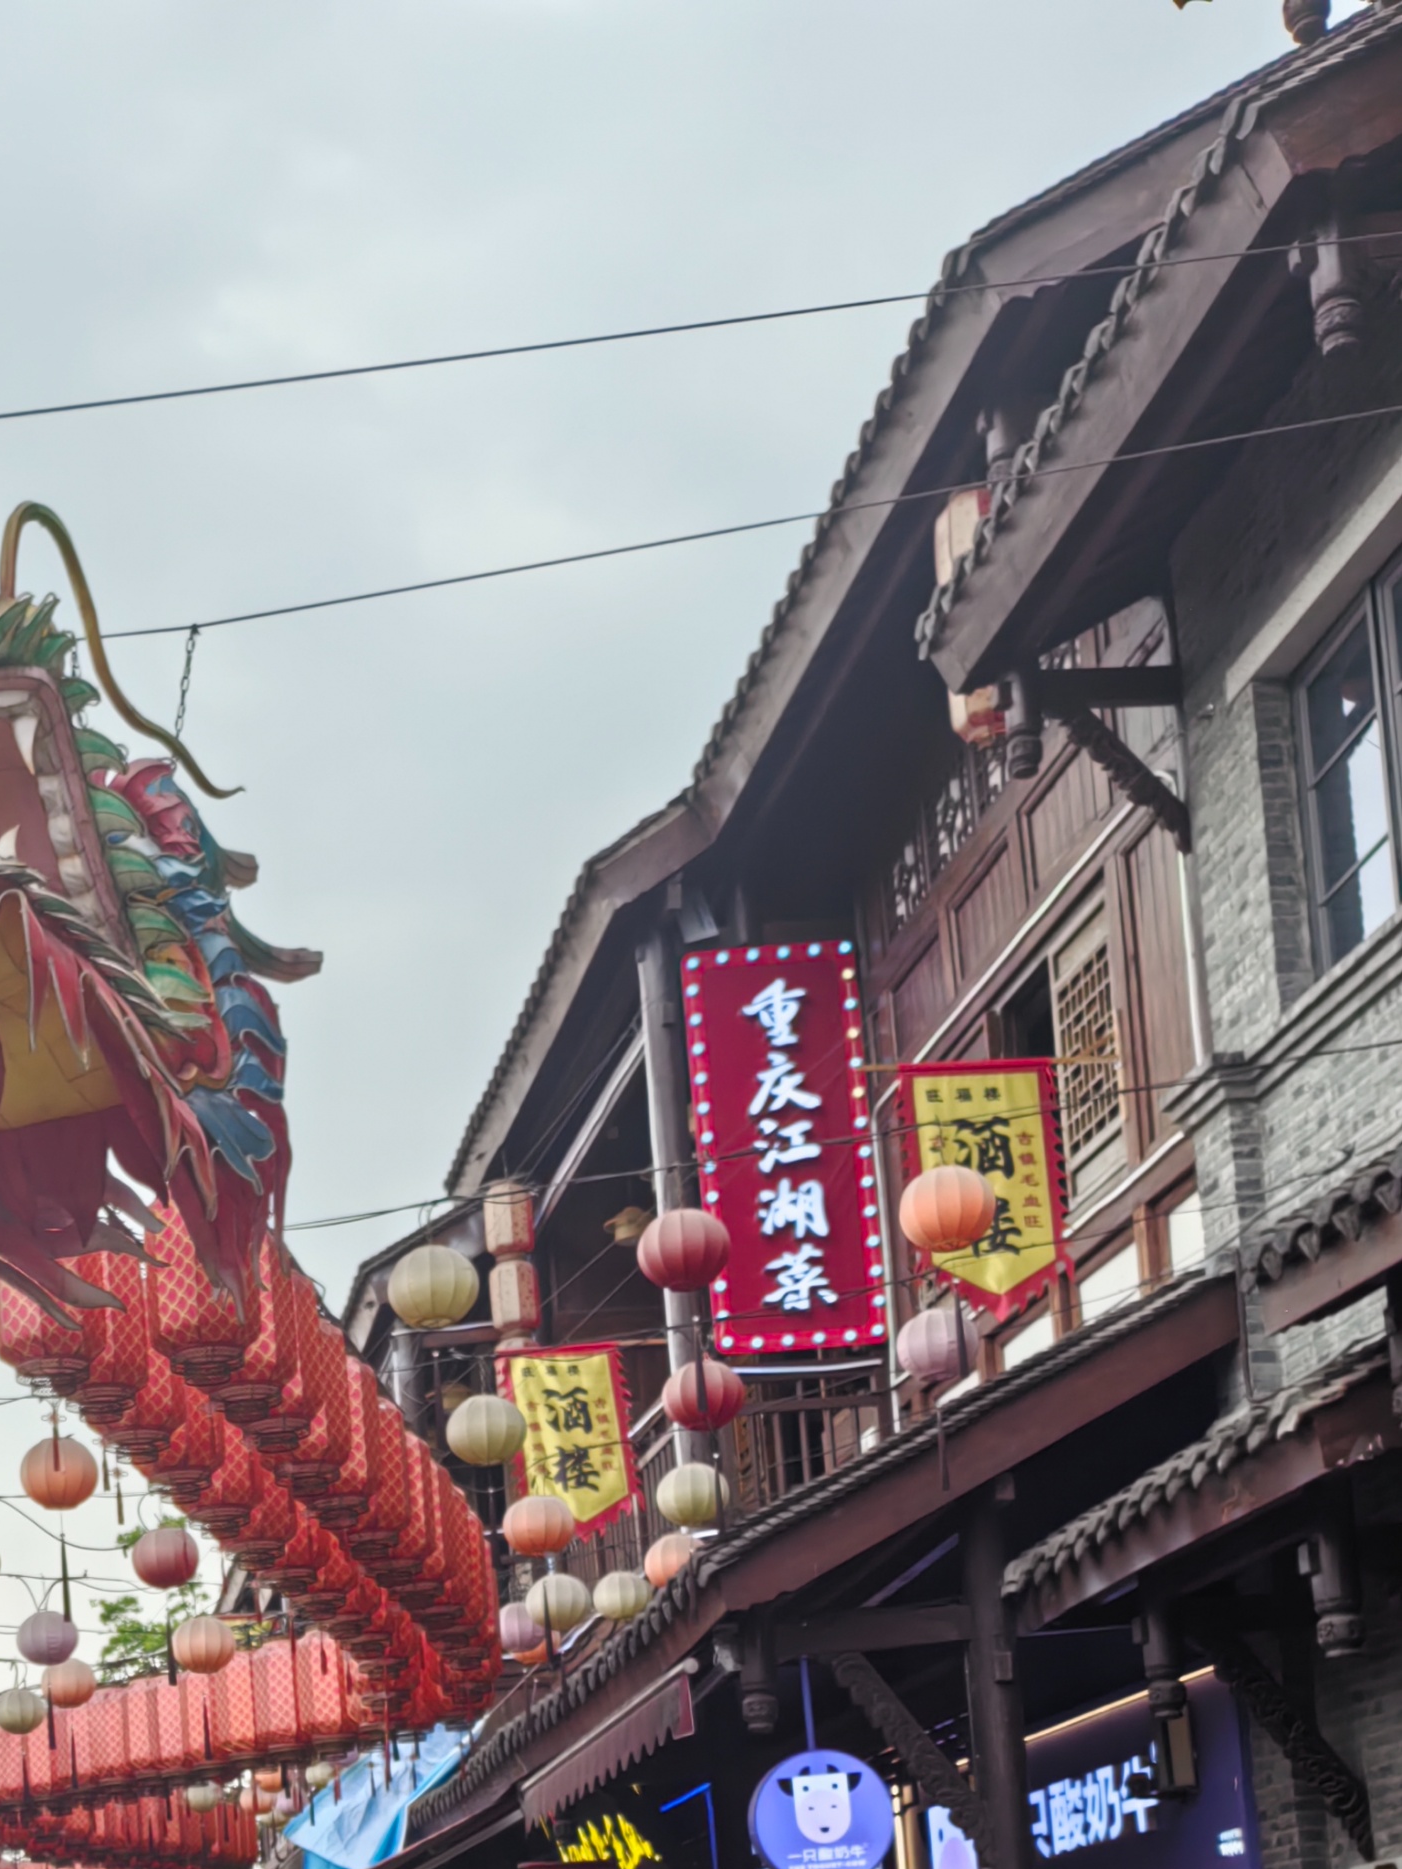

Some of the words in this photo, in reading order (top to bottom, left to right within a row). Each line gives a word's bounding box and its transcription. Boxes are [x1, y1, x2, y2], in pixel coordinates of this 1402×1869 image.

[740, 978, 838, 1311] 重庆江湖菜
[541, 1386, 601, 1493] 酒楼
[787, 1845, 866, 1863] 一只酸奶牛
